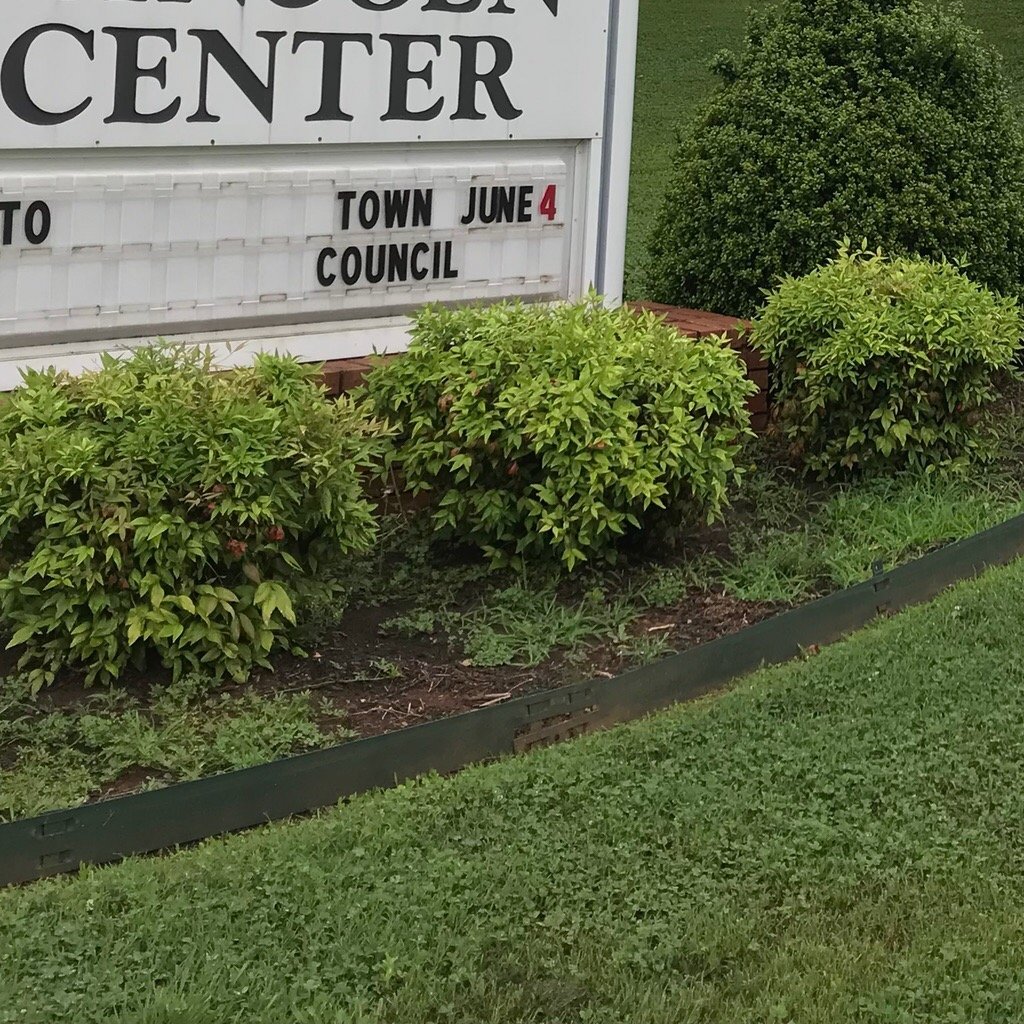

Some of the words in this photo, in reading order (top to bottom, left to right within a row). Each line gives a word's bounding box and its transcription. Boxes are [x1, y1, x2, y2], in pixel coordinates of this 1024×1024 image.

[0, 22, 523, 126] CENTER
[0, 199, 51, 245] TO
[337, 188, 433, 231] TOWN
[316, 240, 459, 288] COUNCIL
